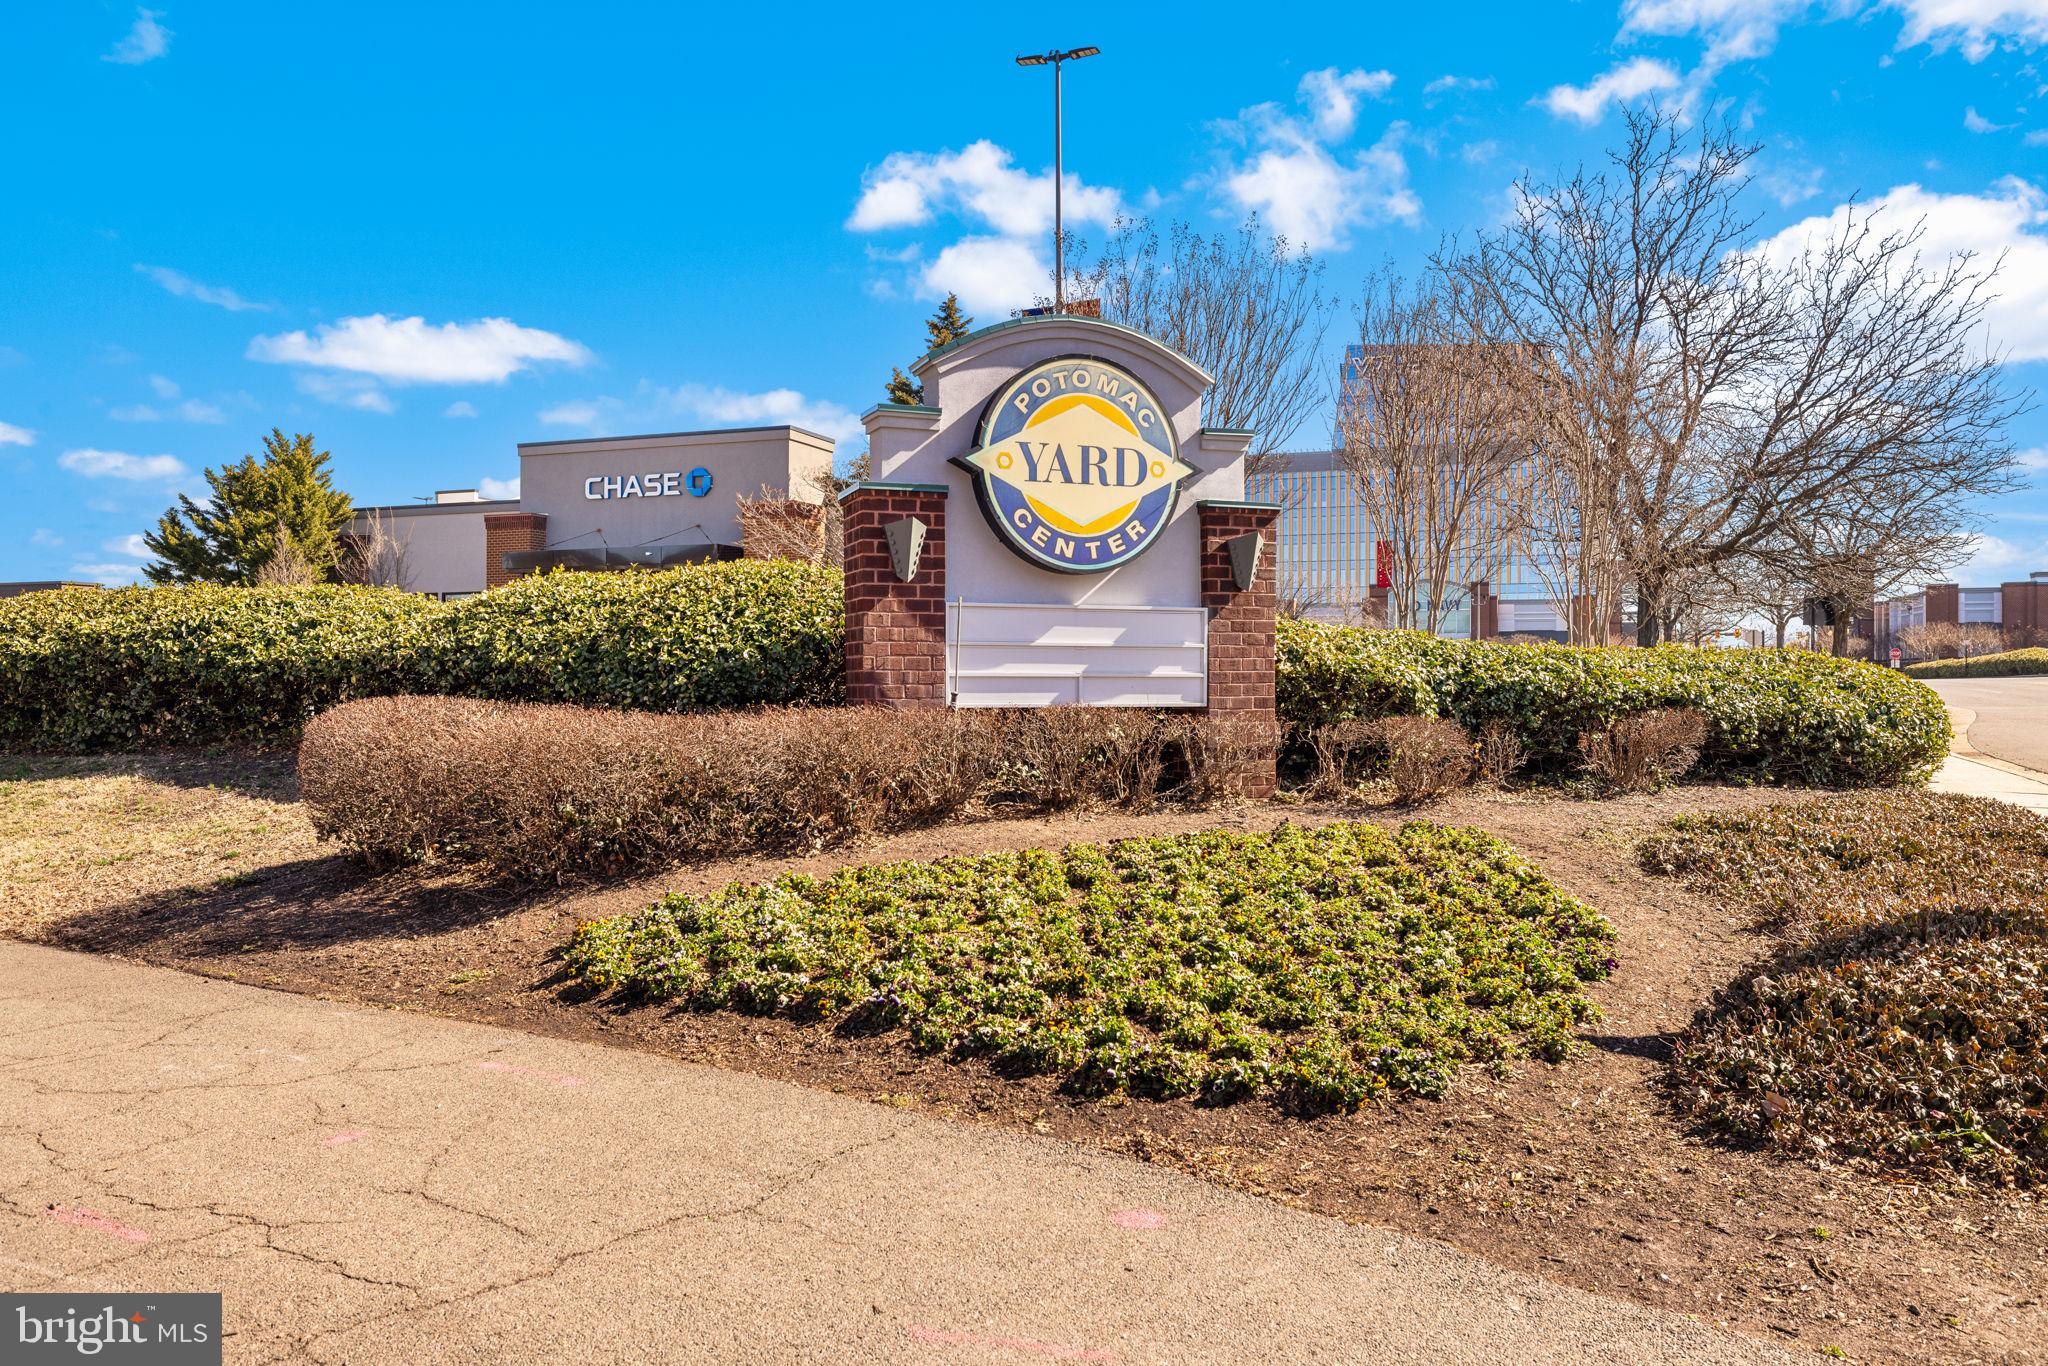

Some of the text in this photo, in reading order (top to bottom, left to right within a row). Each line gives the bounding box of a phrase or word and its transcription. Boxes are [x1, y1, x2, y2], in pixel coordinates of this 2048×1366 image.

[1013, 369, 1156, 428] POTOMAC
[584, 472, 682, 500] CHASE
[1015, 441, 1148, 487] YARD
[1013, 508, 1147, 560] CENTER
